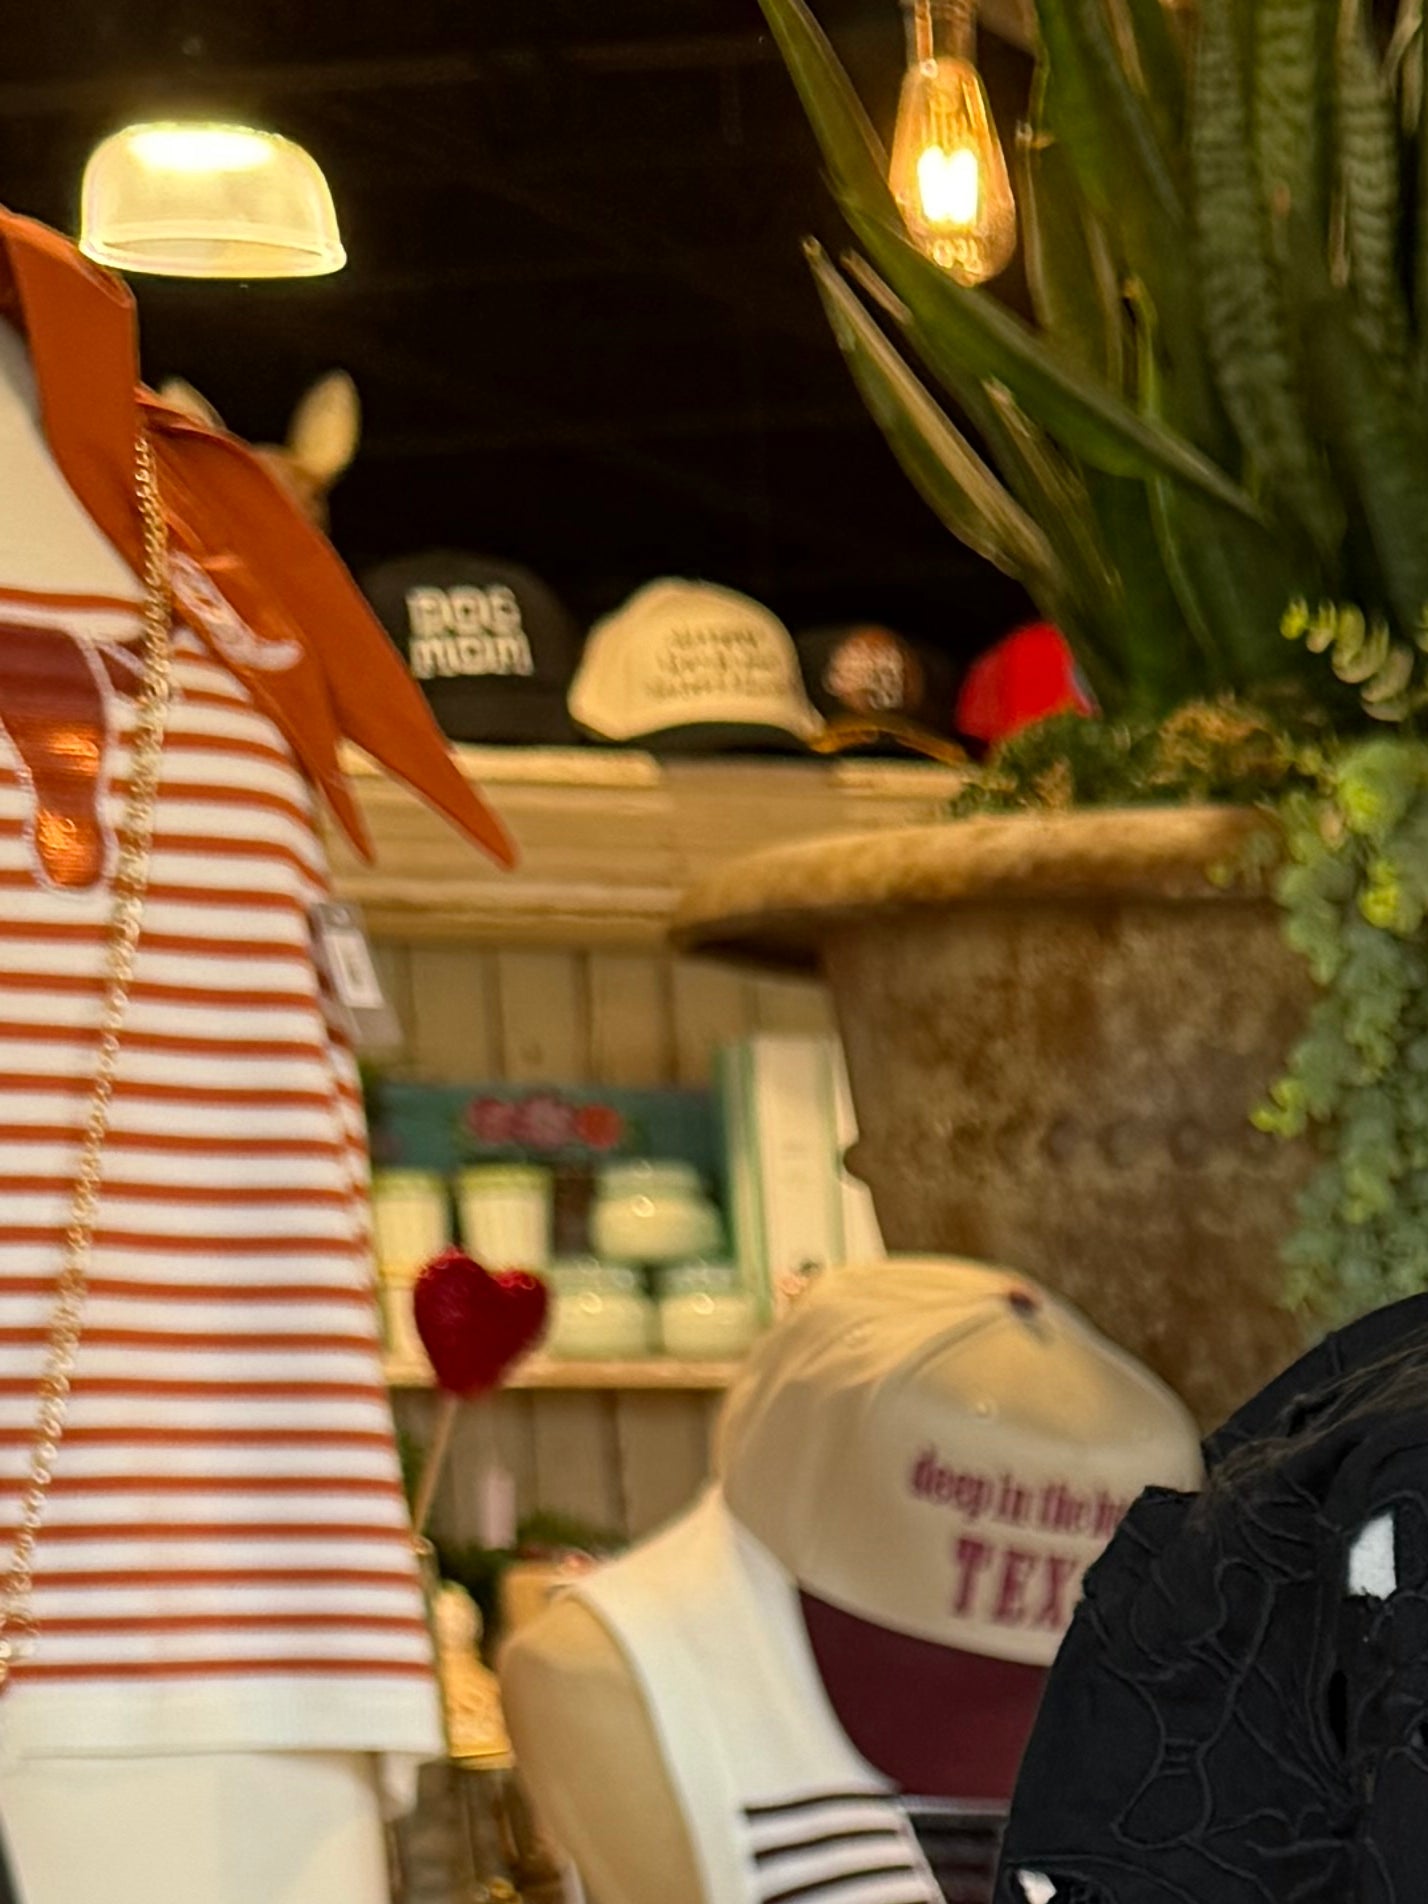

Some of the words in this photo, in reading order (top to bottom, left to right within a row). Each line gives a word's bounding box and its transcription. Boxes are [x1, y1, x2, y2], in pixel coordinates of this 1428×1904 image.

[405, 584, 521, 637] DOG
[911, 1443, 992, 1522] deep
[1000, 1473, 1032, 1526] in
[1041, 1483, 1090, 1534] the
[953, 1536, 1084, 1631] TEX
